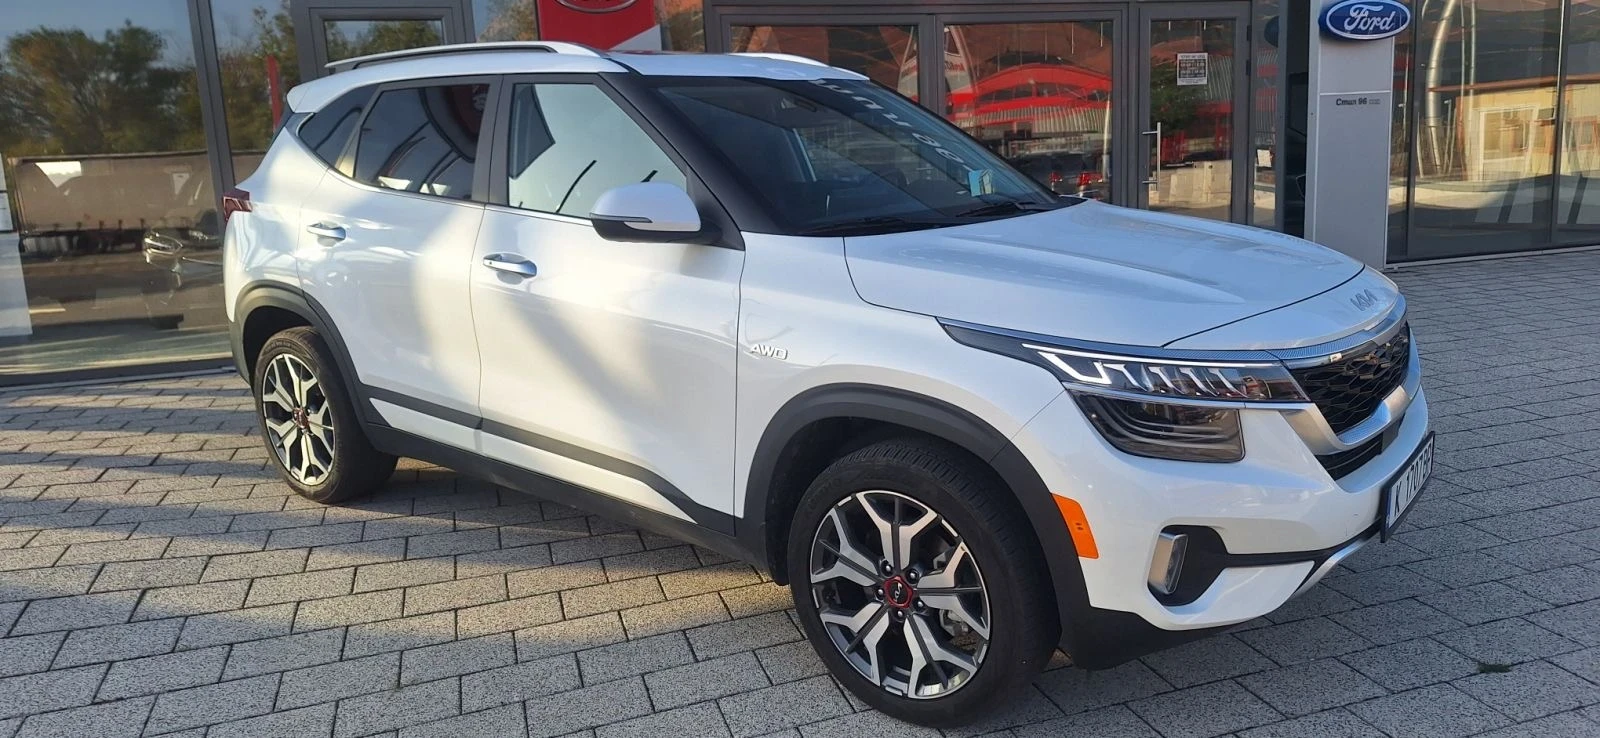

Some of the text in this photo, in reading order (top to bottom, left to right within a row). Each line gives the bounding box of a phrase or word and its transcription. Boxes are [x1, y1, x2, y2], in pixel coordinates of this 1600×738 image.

[1343, 4, 1397, 31] Ford
[1358, 97, 1368, 105] 96
[750, 343, 788, 360] AWD
